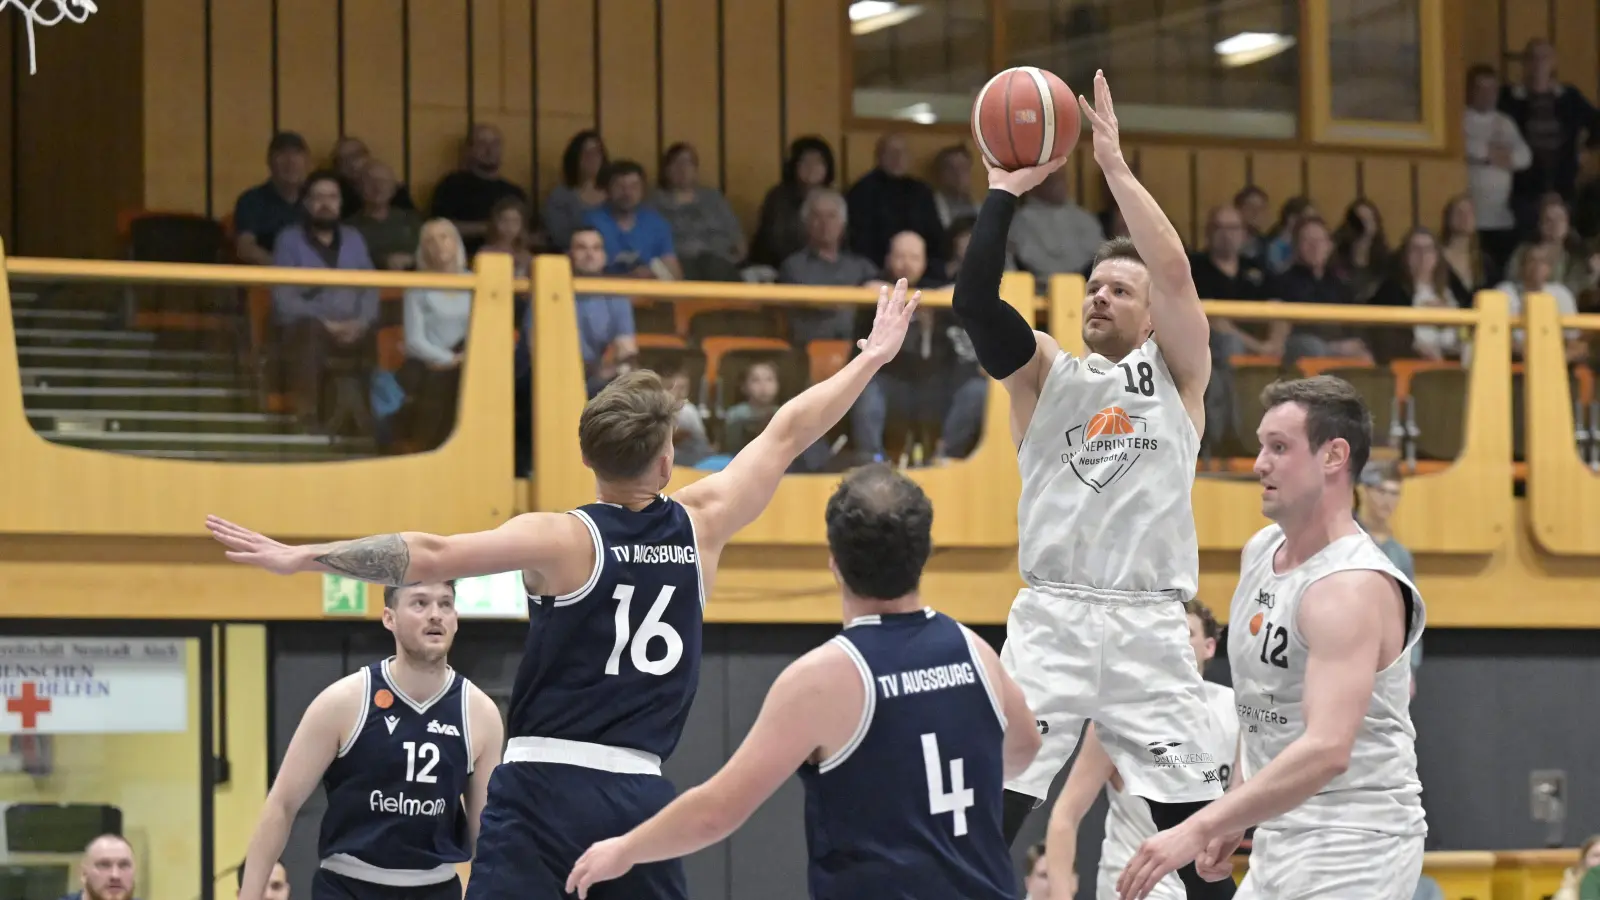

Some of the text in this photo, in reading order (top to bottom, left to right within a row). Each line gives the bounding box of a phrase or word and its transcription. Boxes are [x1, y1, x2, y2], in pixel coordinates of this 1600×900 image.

[1117, 361, 1155, 397] 18
[1061, 437, 1158, 464] ONNEPRINTERS
[610, 544, 696, 564] TV AUGSBURG
[604, 583, 684, 676] 16
[1260, 621, 1289, 669] 12
[0, 663, 94, 678] ENSCHEN
[878, 662, 975, 699] TV AUGSBURG
[402, 741, 441, 784] 12
[920, 732, 975, 837] 4
